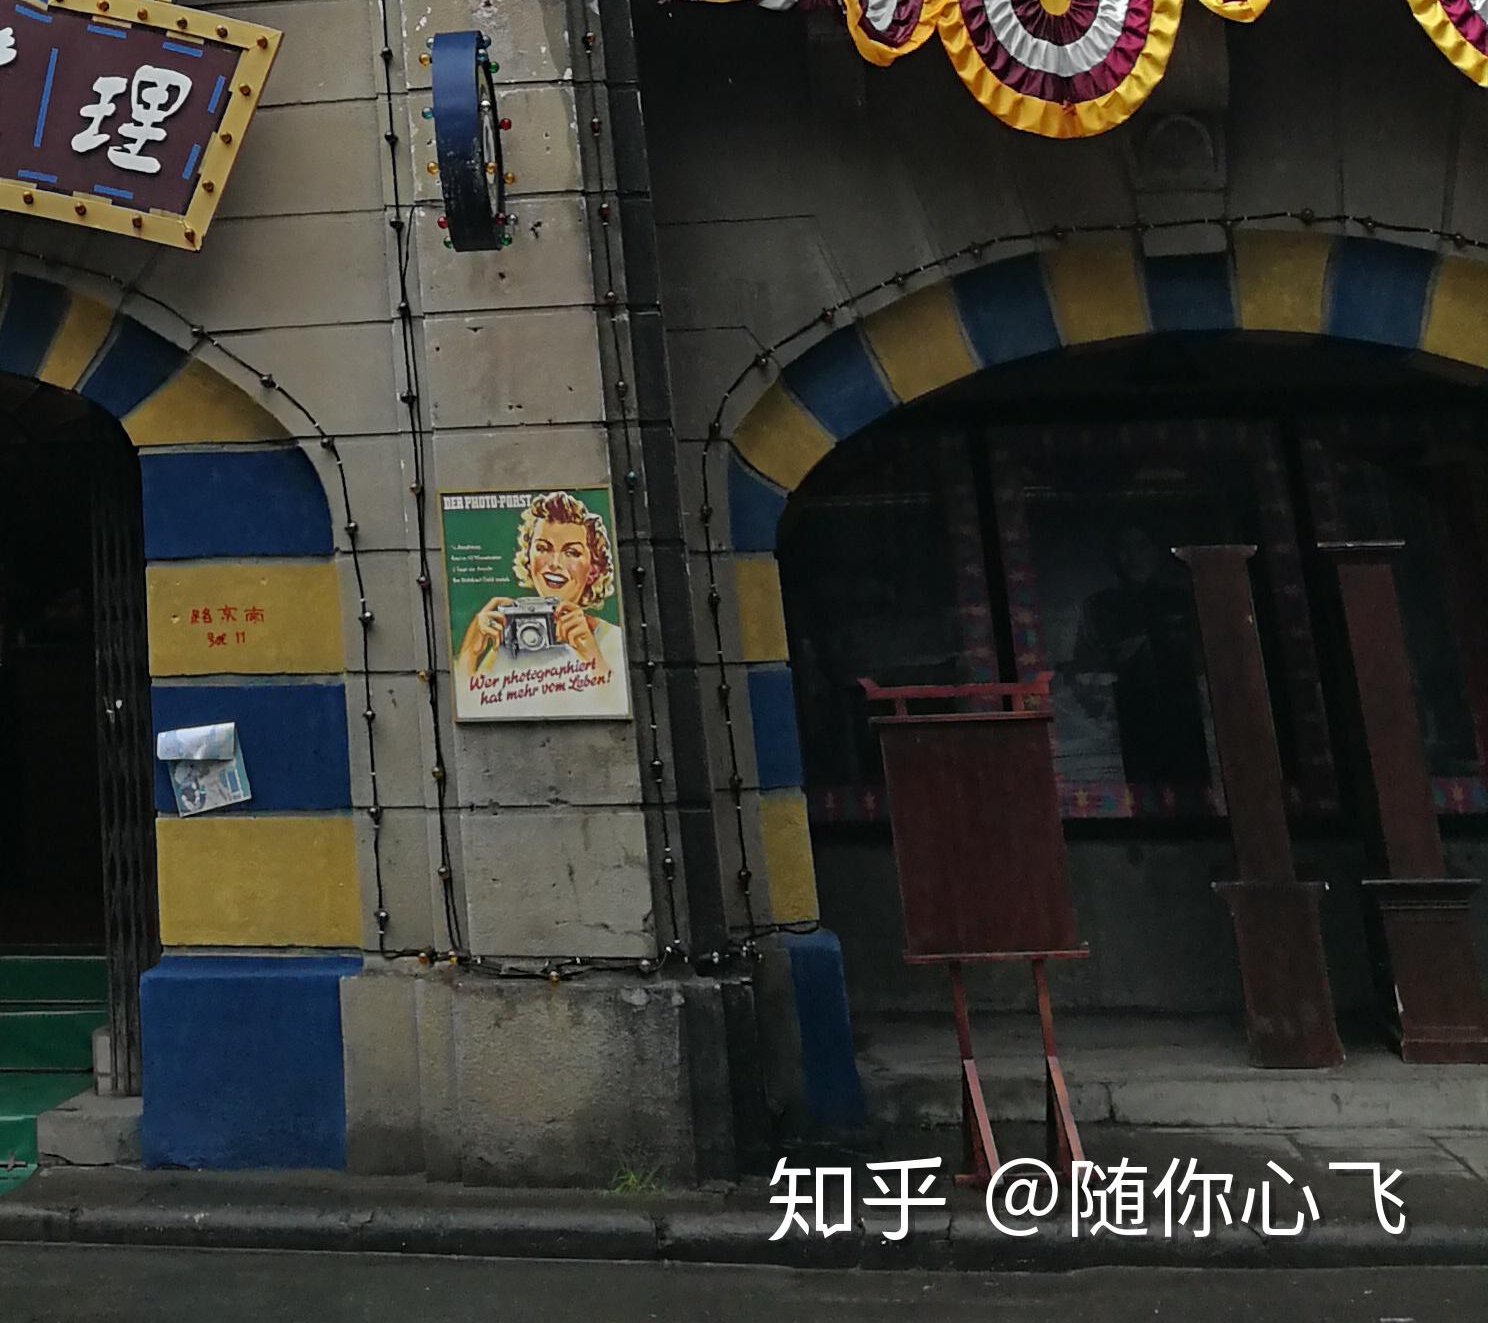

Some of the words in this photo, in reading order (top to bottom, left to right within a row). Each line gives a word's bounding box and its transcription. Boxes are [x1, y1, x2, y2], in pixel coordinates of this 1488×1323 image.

[443, 495, 464, 510] DER
[469, 674, 500, 691] Wer
[502, 657, 596, 689] photographiert
[480, 690, 503, 706] hat
[506, 683, 539, 701] mehr
[541, 681, 566, 695] vom
[568, 670, 613, 693] Leben!
